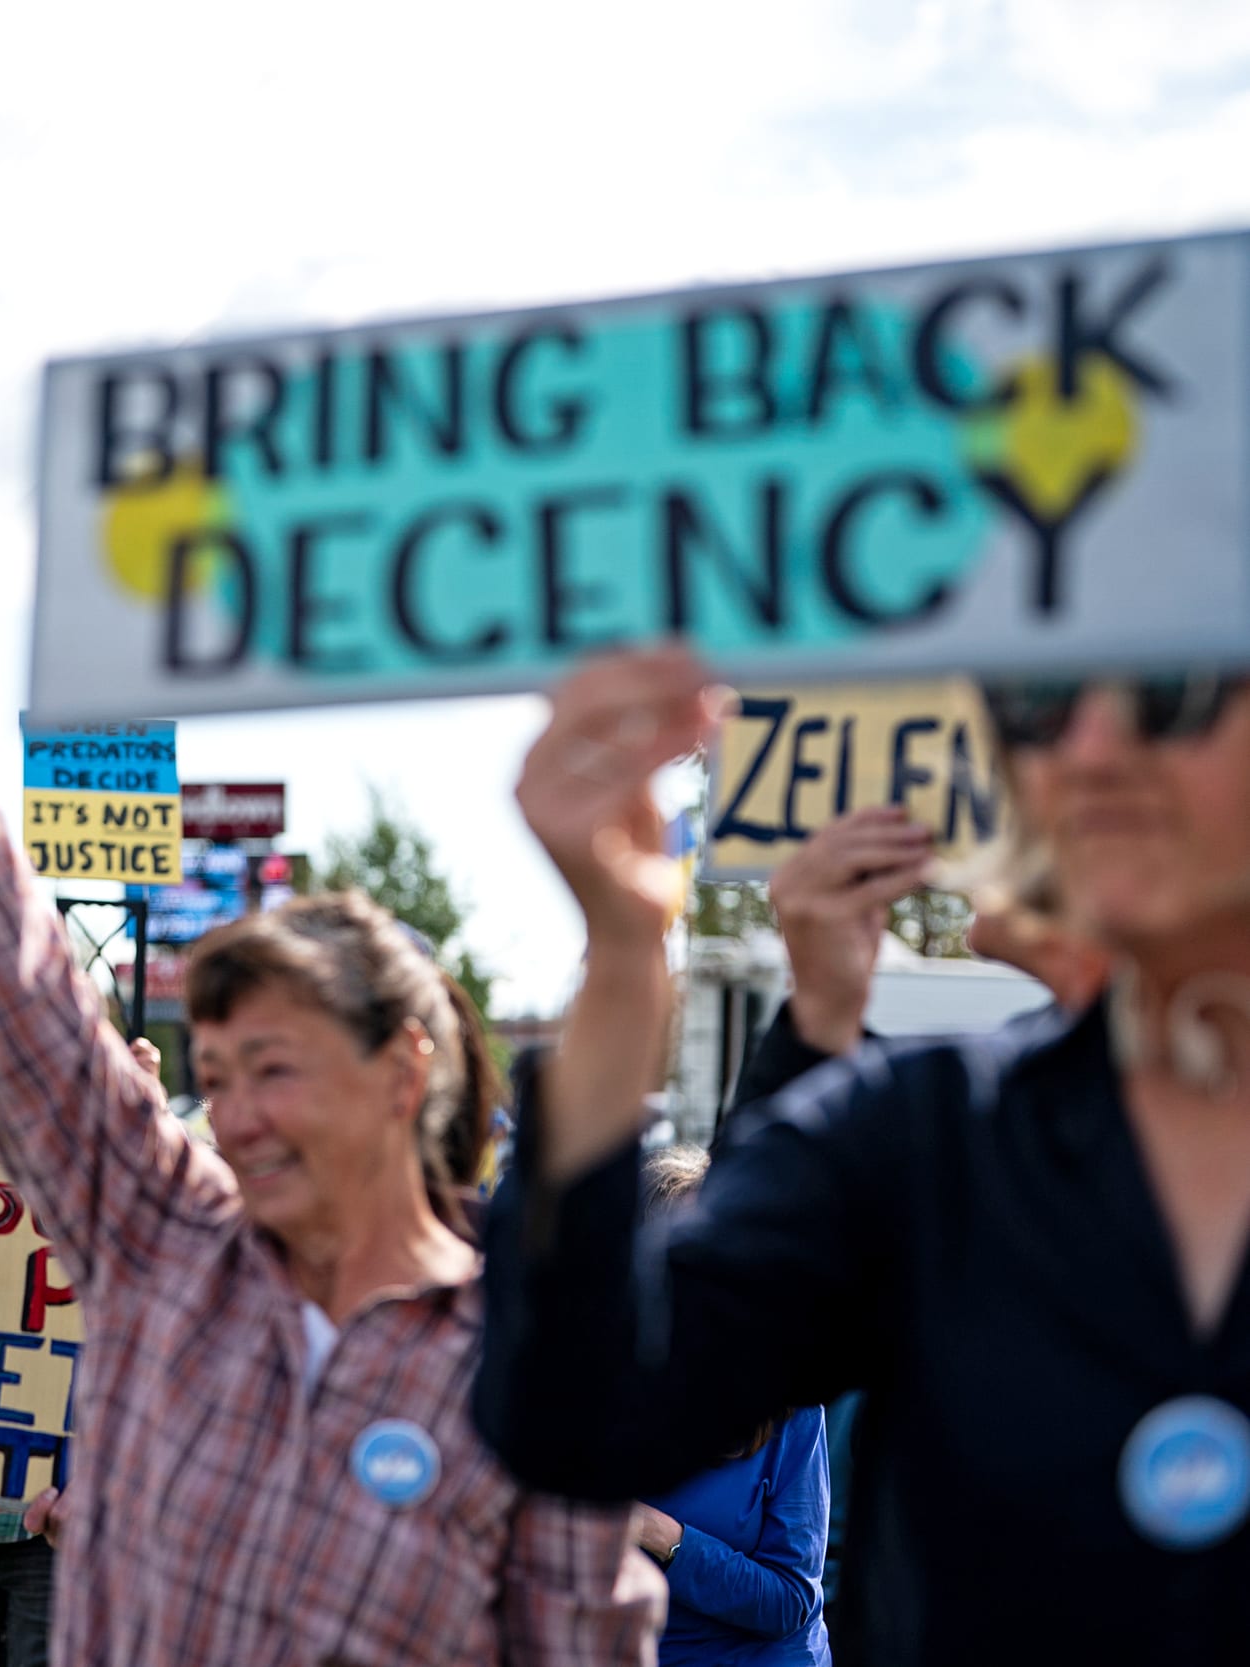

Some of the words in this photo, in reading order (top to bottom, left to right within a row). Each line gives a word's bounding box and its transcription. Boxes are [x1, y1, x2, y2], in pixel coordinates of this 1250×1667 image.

[89, 312, 596, 493] BRING
[674, 256, 1180, 446] BACK
[160, 454, 1119, 680] DECENCY
[28, 741, 176, 762] PREDATORS
[54, 768, 158, 790] DECIDE
[32, 802, 88, 824] IT'S
[103, 804, 173, 829] NOT
[31, 841, 171, 875] JUSTICE
